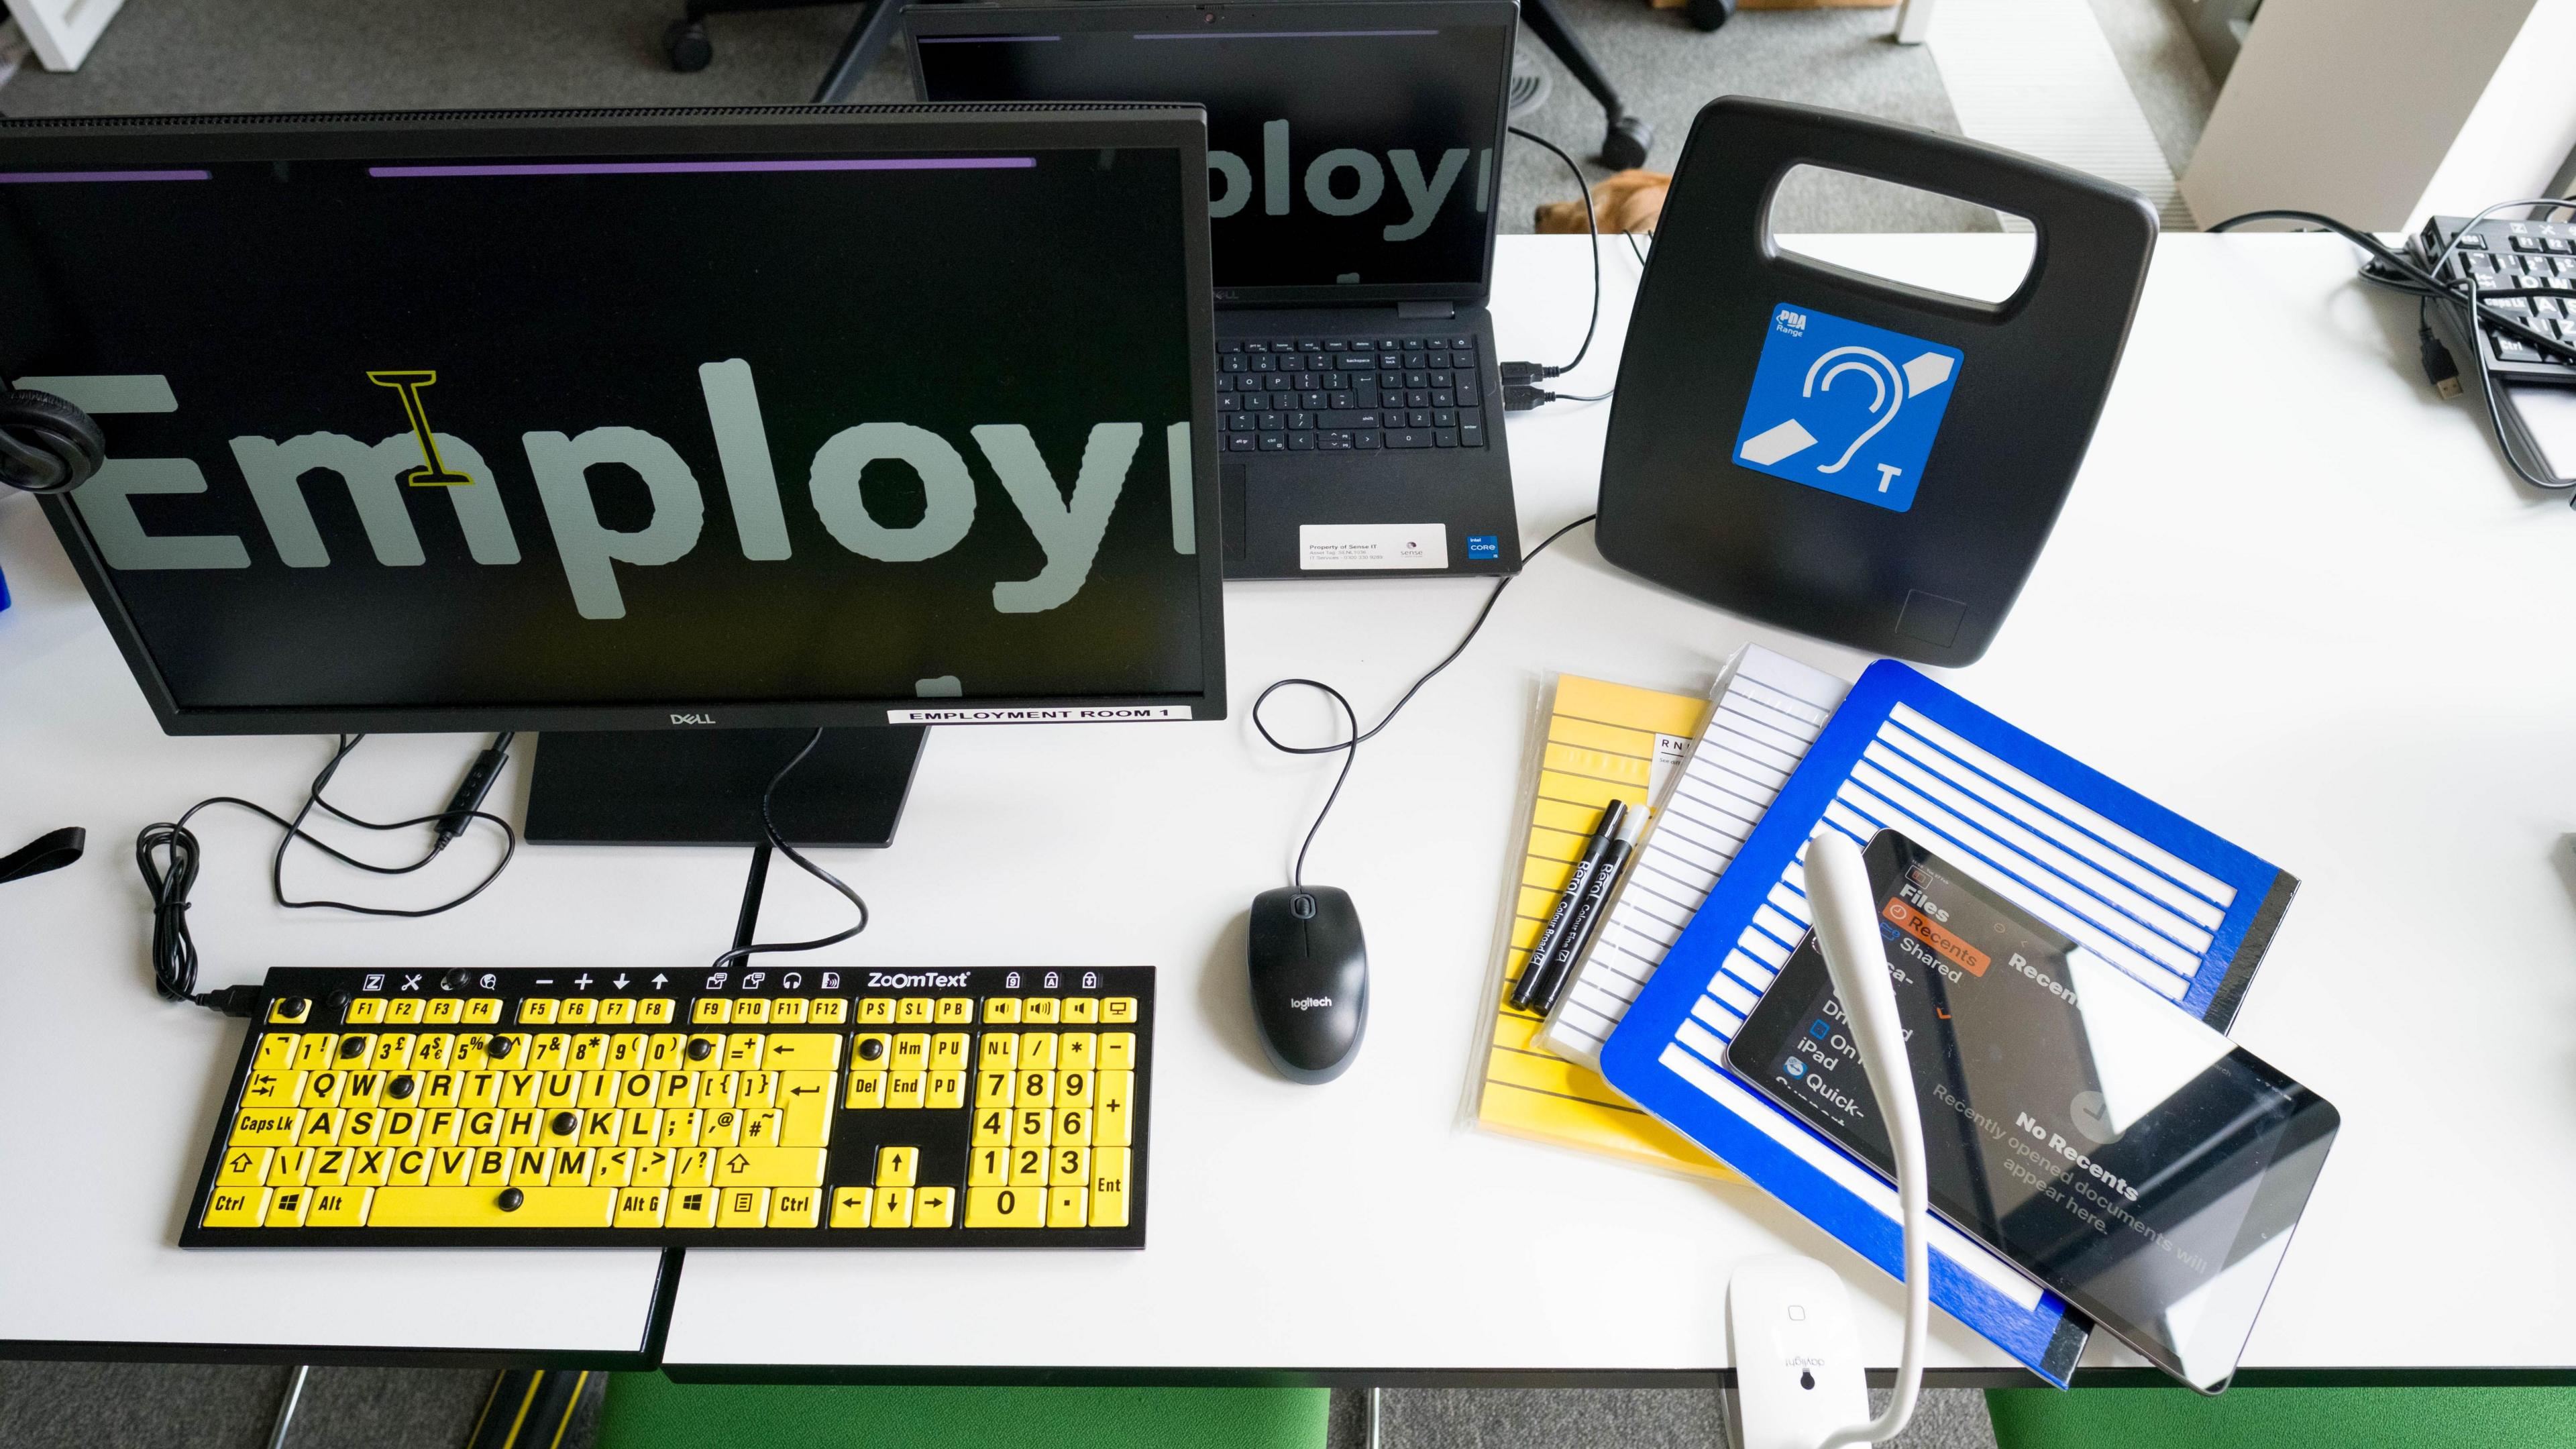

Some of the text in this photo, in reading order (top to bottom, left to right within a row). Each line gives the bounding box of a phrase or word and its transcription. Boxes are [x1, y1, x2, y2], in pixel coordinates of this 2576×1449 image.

[1776, 324, 1803, 337] Range
[1779, 309, 1807, 331] PDA
[12, 358, 1196, 620] Employ
[1876, 463, 1902, 493] T
[669, 713, 716, 725] DELL
[909, 708, 1170, 721] EMPLOYMENT ROOM 1
[1565, 861, 1591, 897] Berol
[1588, 863, 1614, 900] Berol
[1899, 883, 1950, 923] Files
[1536, 901, 1568, 952] Colour Broad
[1562, 904, 1590, 949] Colour Fine
[1908, 915, 1978, 967] Recents
[1900, 937, 1964, 985] Shared
[2008, 953, 2082, 1010] Recen
[358, 1002, 372, 1014] F1
[395, 1003, 411, 1015] F2
[434, 1003, 450, 1015] F3
[472, 1002, 488, 1015] F4
[530, 1003, 545, 1015] F5
[568, 1003, 584, 1015] F6
[607, 1003, 623, 1015] F7
[645, 1003, 661, 1015] F8
[704, 1003, 718, 1015] F9
[738, 1002, 761, 1015] F10
[777, 1003, 799, 1015] F11
[816, 1003, 838, 1015] F12
[1291, 996, 1332, 1011] logitech
[899, 1041, 920, 1055] Hm
[1796, 1036, 1839, 1071] iPad
[1830, 1034, 1857, 1059] On
[313, 1073, 335, 1098] Q
[352, 1074, 377, 1096] W
[430, 1075, 451, 1096] R
[474, 1074, 492, 1096] T
[513, 1075, 533, 1096] Y
[549, 1075, 572, 1097] U
[594, 1075, 604, 1096] I
[627, 1074, 650, 1097] O
[668, 1074, 688, 1097] P
[856, 1079, 877, 1093] Del
[894, 1079, 918, 1093] End
[989, 1074, 1005, 1095] 7
[1026, 1074, 1043, 1096] 8
[1067, 1073, 1083, 1096] 9
[1806, 1073, 1865, 1118] Quick-
[240, 1112, 1081, 1135] Caps Lk A S D F G H K L 4 5 6
[319, 1150, 1078, 1174] Z X C V B N M 1 2 3
[2015, 1111, 2141, 1201] No Recents
[215, 1178, 1120, 1215] Ctrl Alt Alt G Ctrl 0 Ent
[1932, 1083, 2208, 1274] Recently opened documents will
[2003, 1155, 2109, 1235] appear here.
